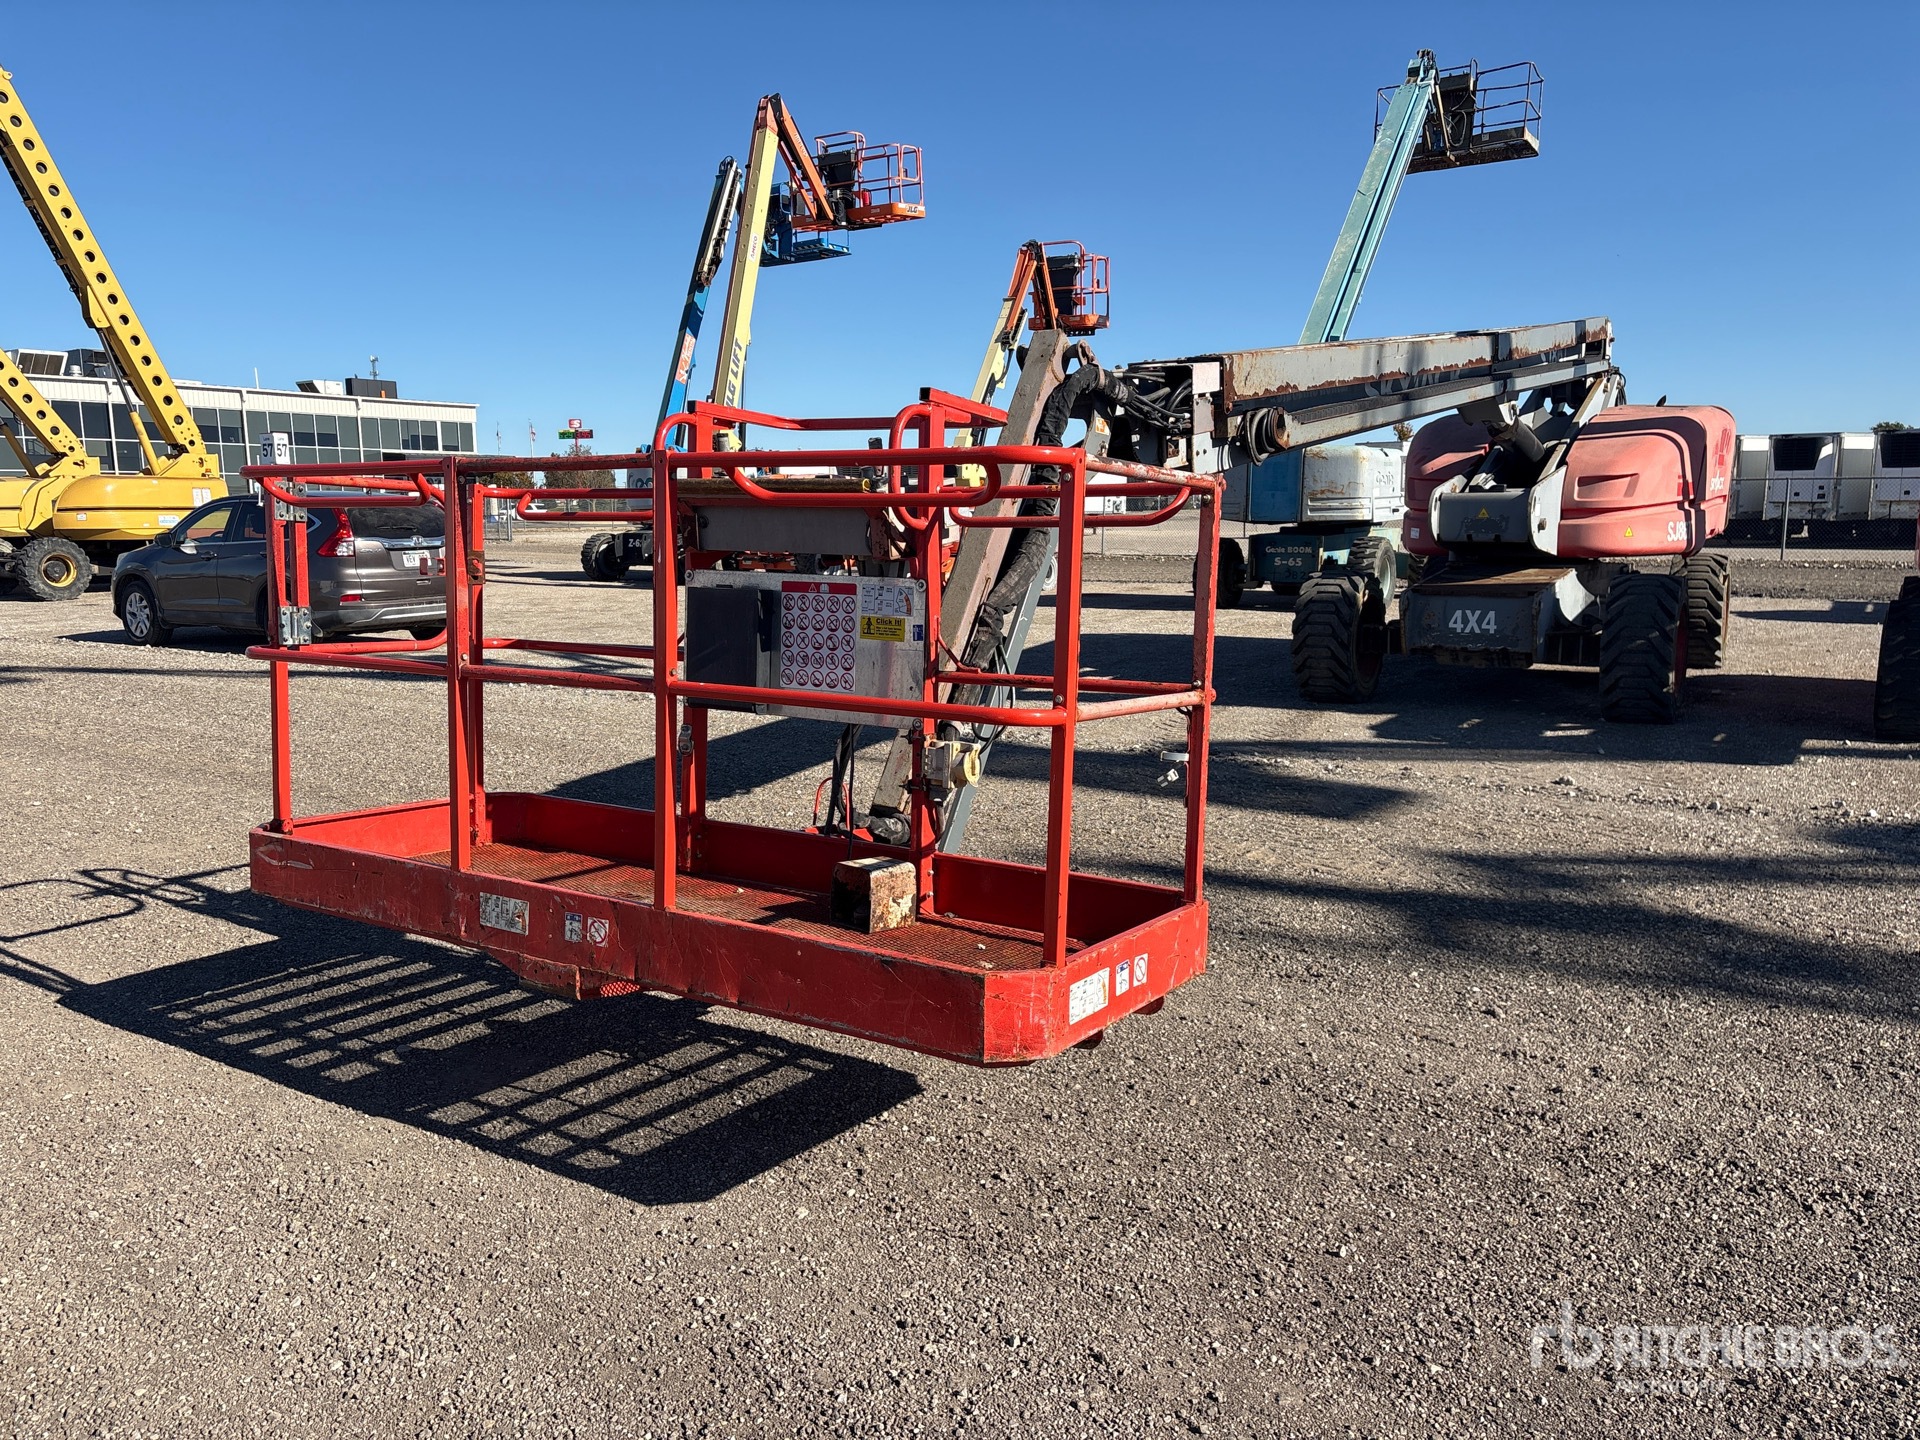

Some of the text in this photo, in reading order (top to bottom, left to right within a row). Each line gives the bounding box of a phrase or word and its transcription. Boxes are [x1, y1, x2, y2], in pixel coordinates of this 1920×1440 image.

[730, 336, 743, 380] LIFT
[262, 443, 273, 457] 57
[276, 443, 287, 457] 57
[1265, 546, 1313, 554] Genie BOOM
[1274, 557, 1303, 567] S-65
[875, 617, 893, 625] Click
[1448, 609, 1498, 635] 4X4
